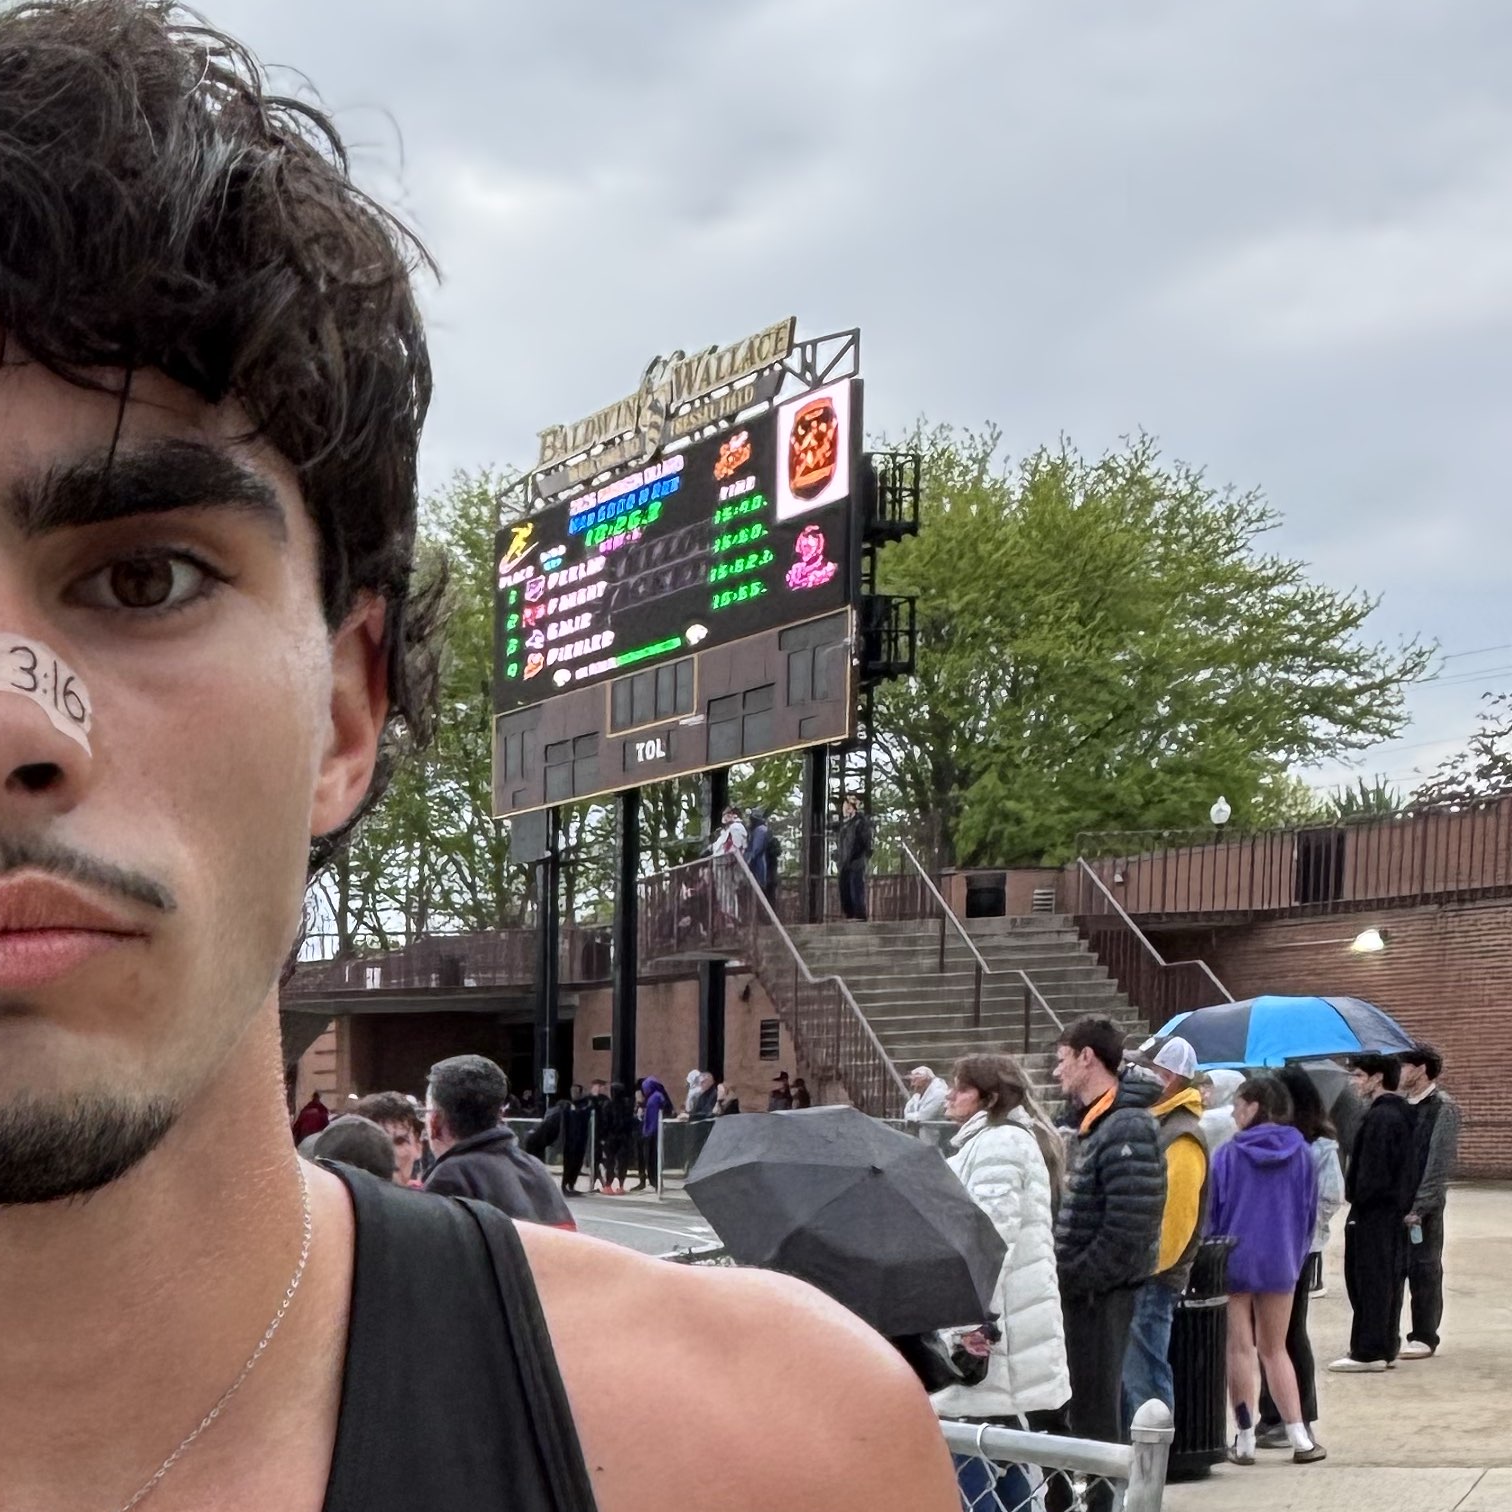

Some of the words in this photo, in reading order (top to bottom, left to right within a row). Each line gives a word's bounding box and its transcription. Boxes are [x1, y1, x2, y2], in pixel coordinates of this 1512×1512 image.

[539, 396, 638, 461] BALDWIN
[672, 324, 789, 402] WALLACE
[9, 646, 86, 723] 3:16
[636, 738, 666, 762] TOL
